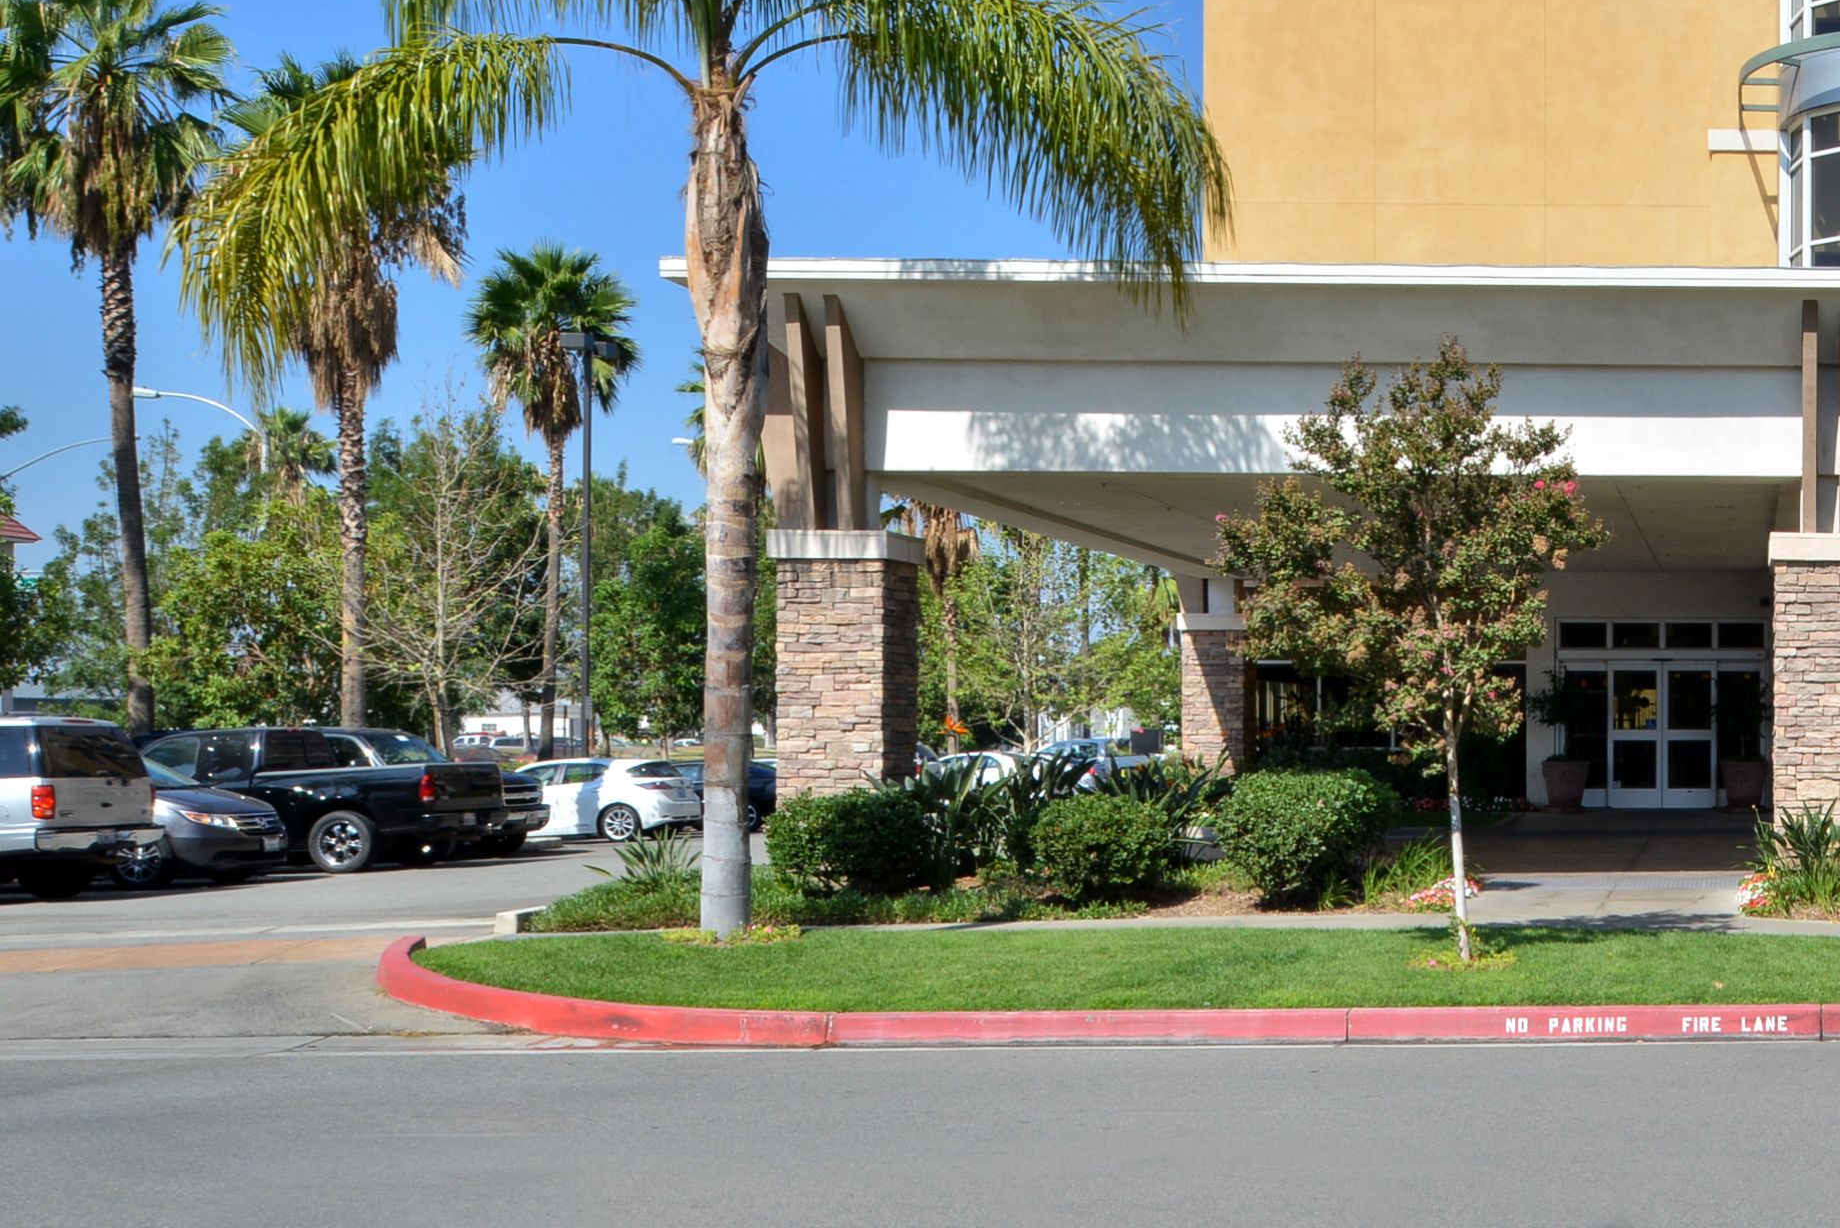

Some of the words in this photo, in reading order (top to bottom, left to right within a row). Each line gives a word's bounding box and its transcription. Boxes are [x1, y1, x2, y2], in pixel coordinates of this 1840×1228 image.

[1505, 1017, 1528, 1033] NO
[1548, 1016, 1627, 1033] PARKING
[1682, 1017, 1721, 1032] FIRE
[1741, 1016, 1788, 1032] LANE
